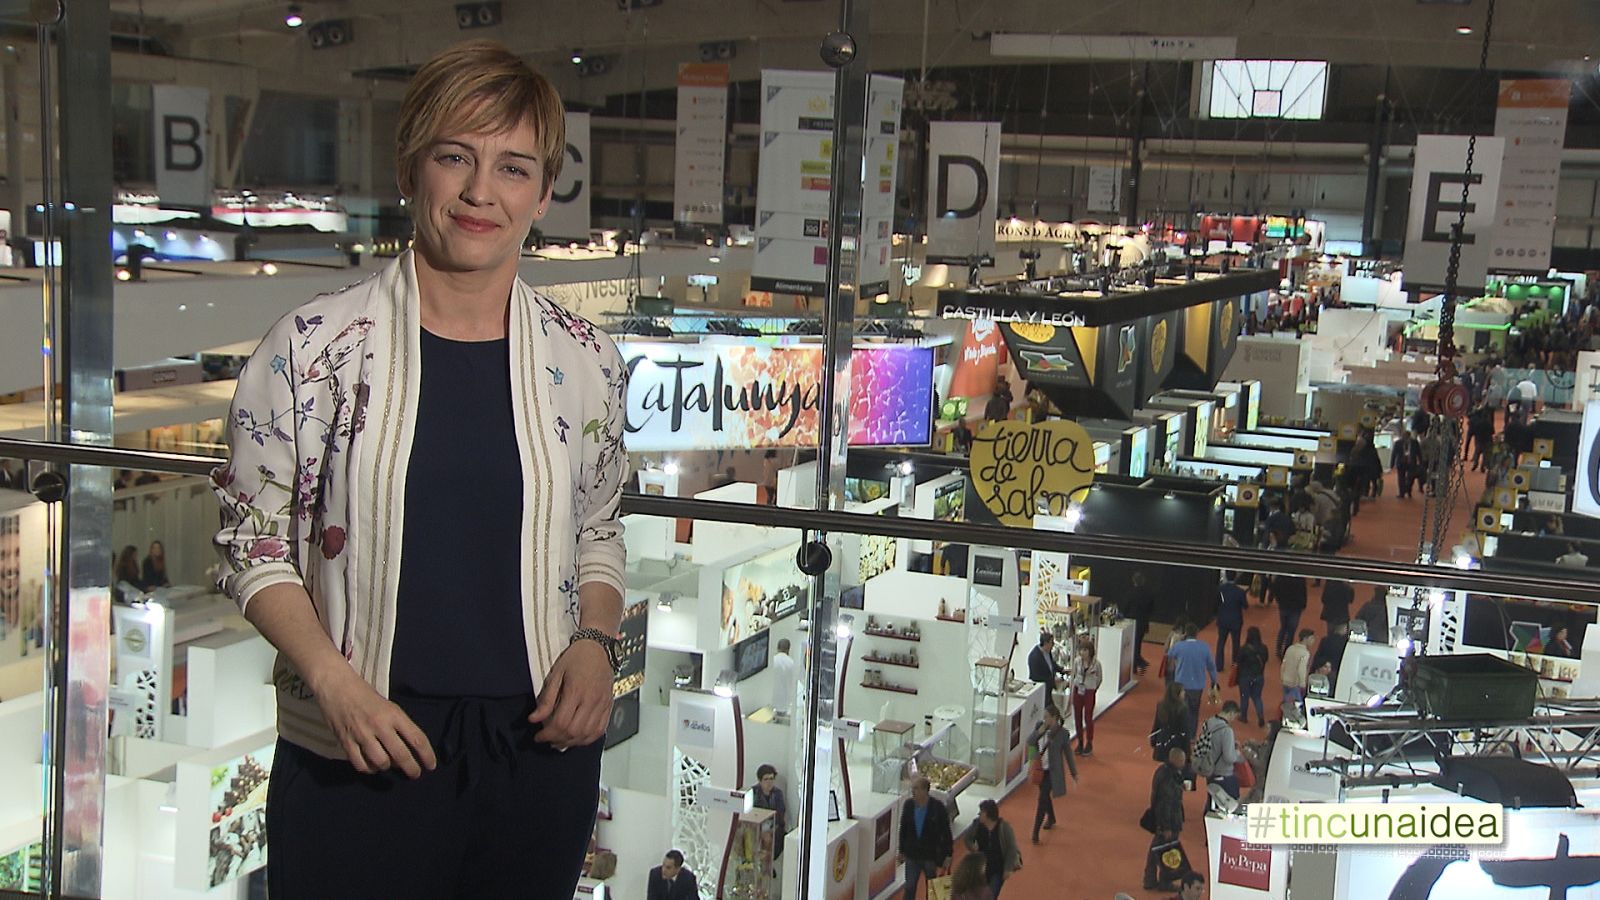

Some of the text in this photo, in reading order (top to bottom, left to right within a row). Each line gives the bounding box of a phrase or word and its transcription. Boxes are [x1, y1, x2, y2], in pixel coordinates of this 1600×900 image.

[163, 114, 204, 171] B
[936, 155, 988, 218] D
[1422, 171, 1482, 244] E
[997, 225, 1030, 237] RONS
[943, 305, 1086, 328] CASTILLA Y LEÓN
[624, 352, 822, 439] Catalunya
[973, 426, 1091, 472] tierra
[980, 460, 1017, 484] de
